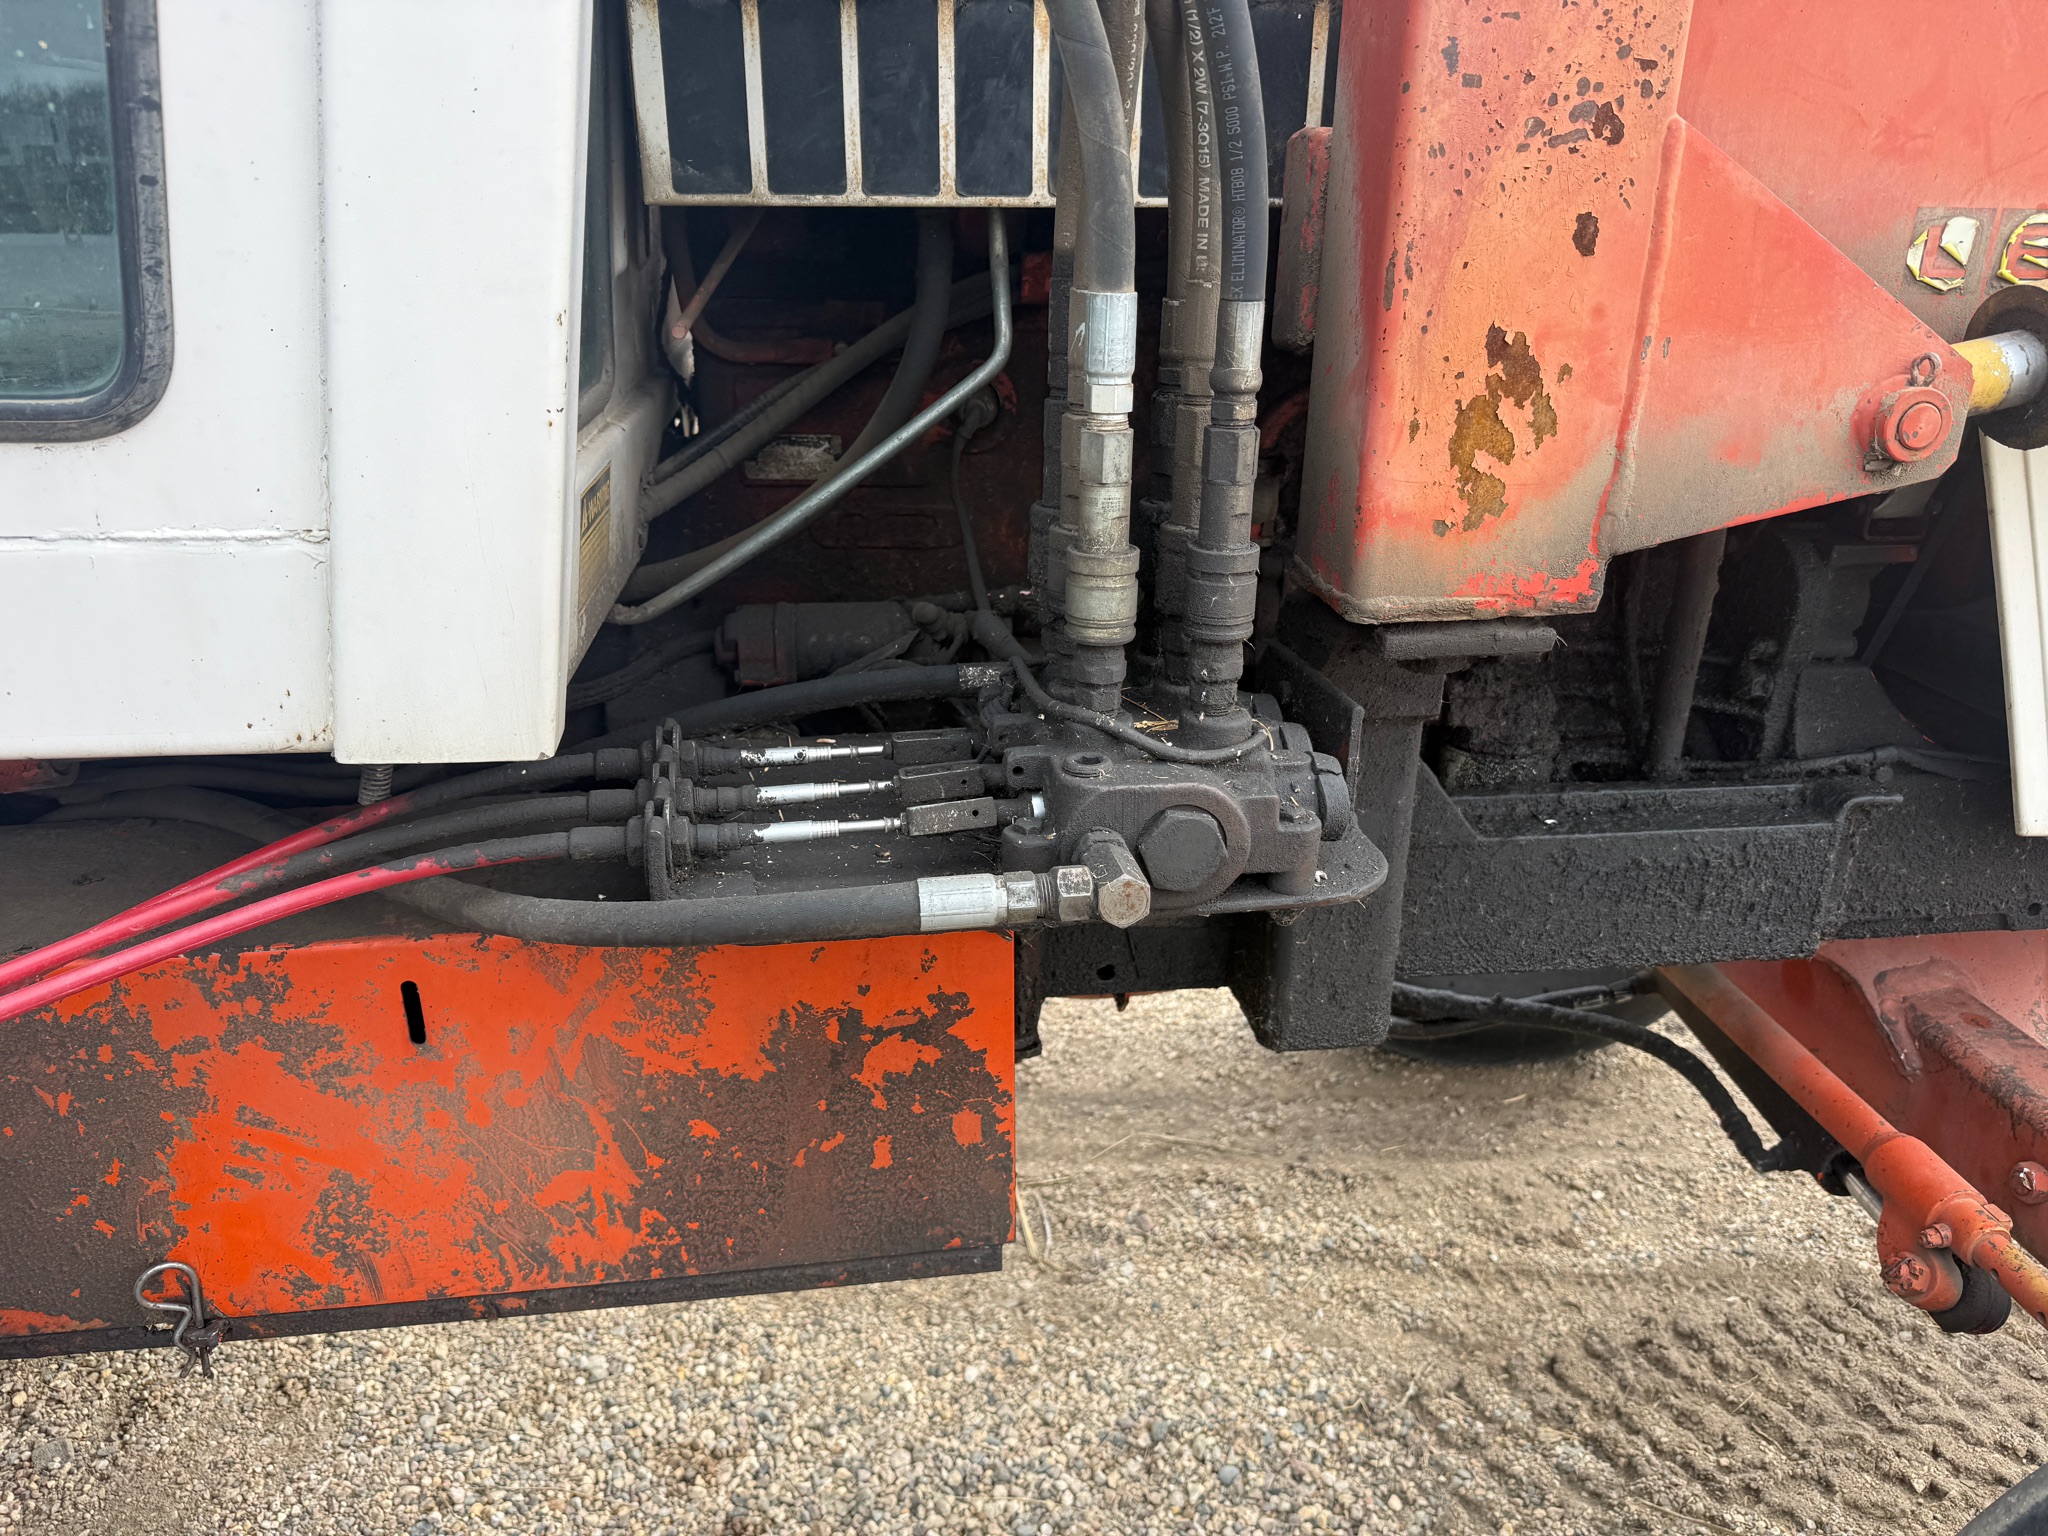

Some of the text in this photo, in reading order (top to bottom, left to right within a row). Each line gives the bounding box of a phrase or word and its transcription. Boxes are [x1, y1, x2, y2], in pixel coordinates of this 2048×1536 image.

[1186, 9, 1203, 46] (1/2)
[1191, 50, 1204, 63] X
[1193, 68, 1208, 94] 2W
[1195, 100, 1211, 168] (7-3Q15)
[1224, 106, 1241, 135] 5000
[1228, 140, 1243, 160] 1/2
[1230, 167, 1246, 202] HTB08
[1197, 177, 1210, 228] MADE
[1196, 233, 1208, 250] IN
